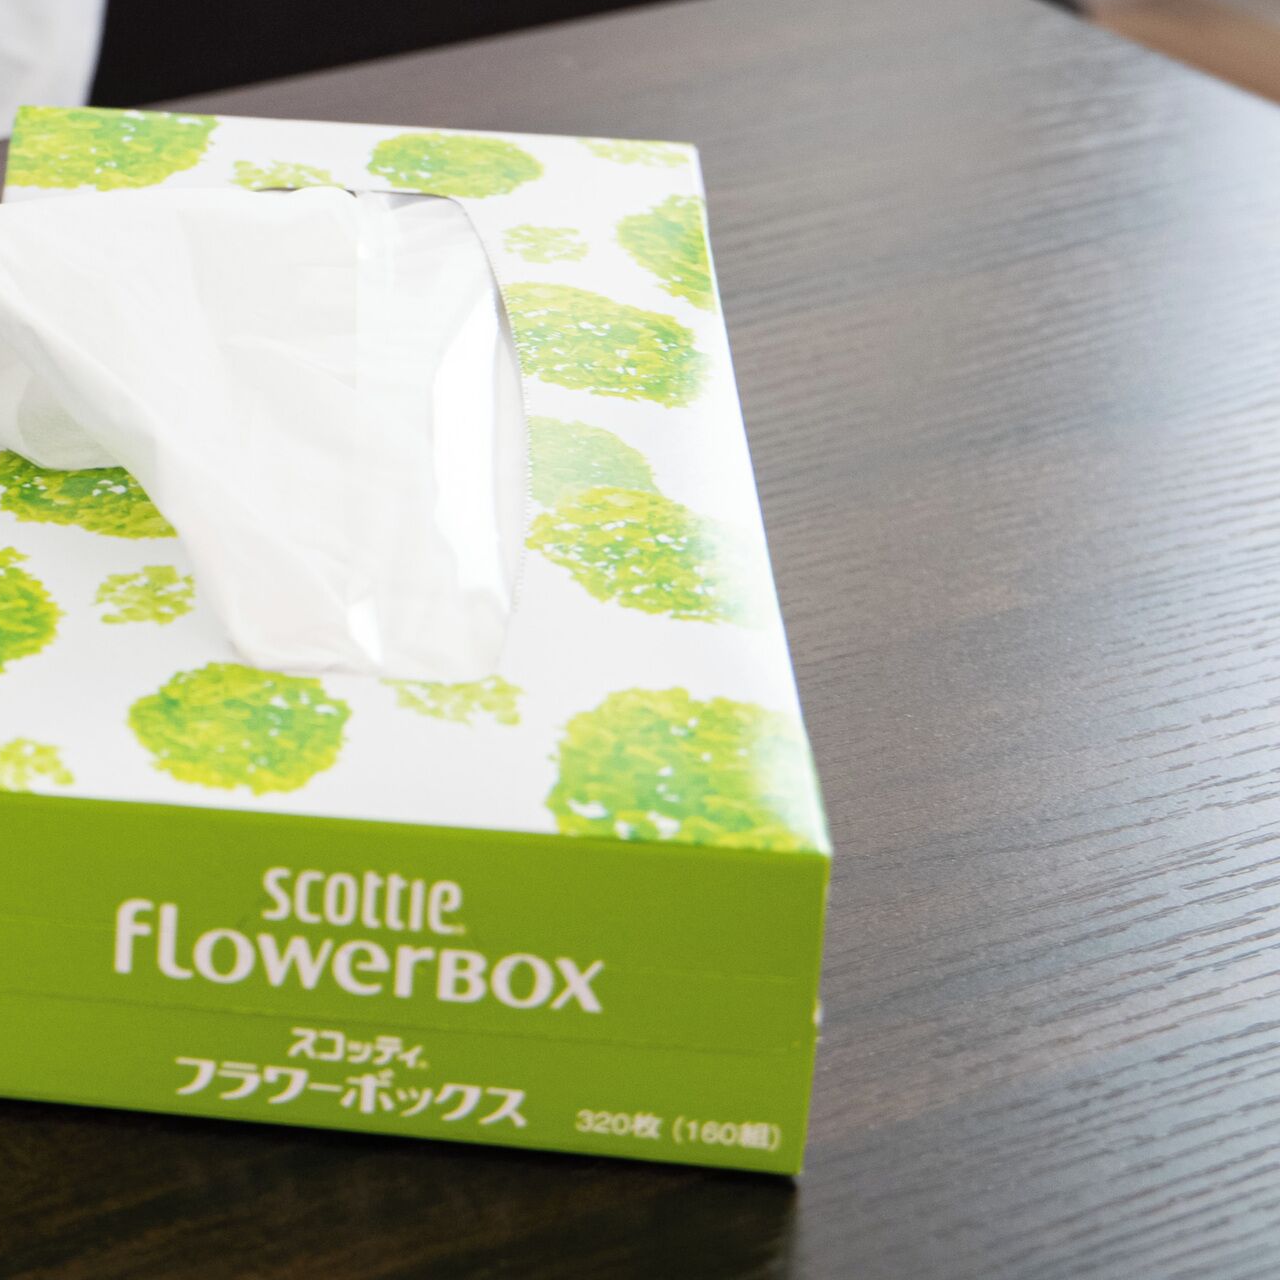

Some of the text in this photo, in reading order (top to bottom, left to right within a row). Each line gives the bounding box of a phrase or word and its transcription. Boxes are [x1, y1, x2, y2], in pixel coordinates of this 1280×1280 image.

[287, 1027, 424, 1068] スコッティ
[174, 1056, 528, 1128] フラワーボックス
